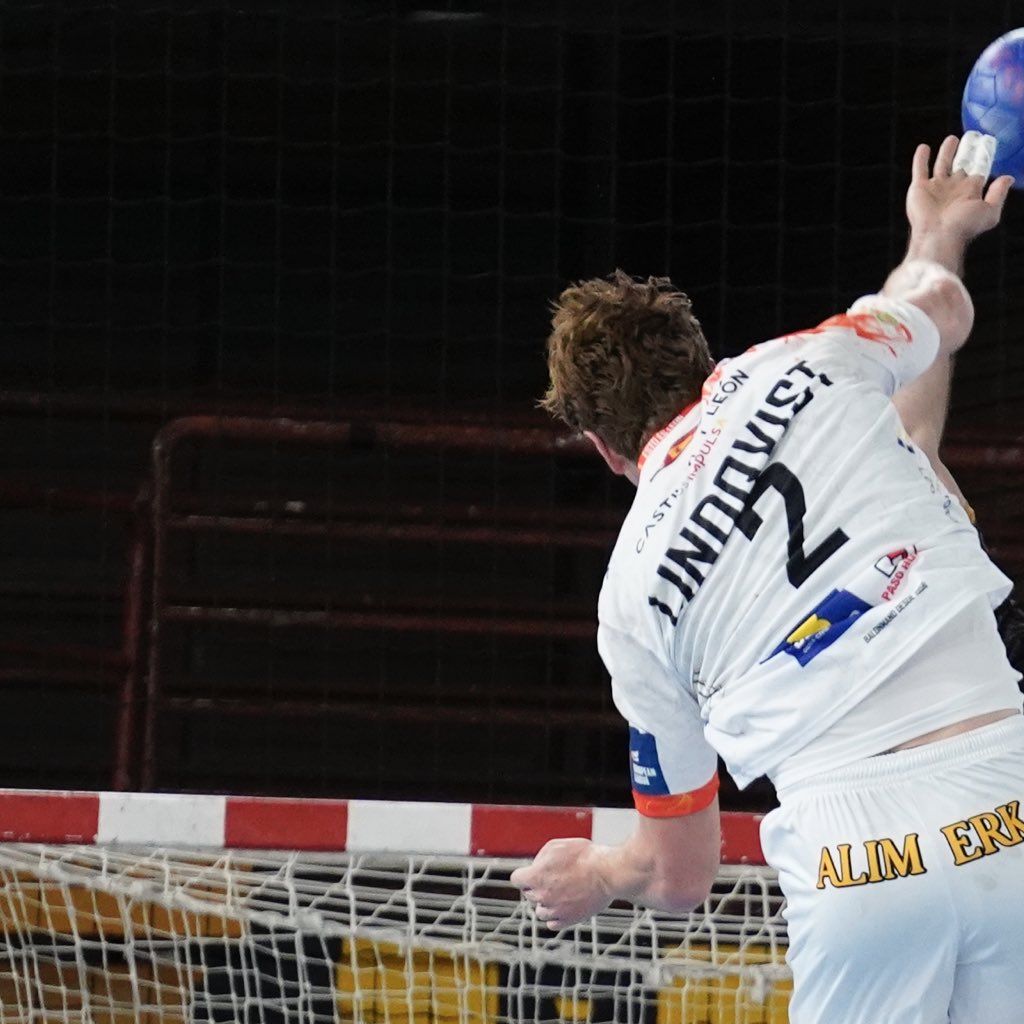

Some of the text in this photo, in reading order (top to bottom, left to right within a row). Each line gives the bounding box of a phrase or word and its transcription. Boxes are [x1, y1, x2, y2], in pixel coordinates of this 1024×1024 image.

[648, 360, 834, 627] LINDQVIST
[733, 461, 850, 589] 2
[881, 572, 905, 602] PASO
[816, 832, 928, 890] ALIM
